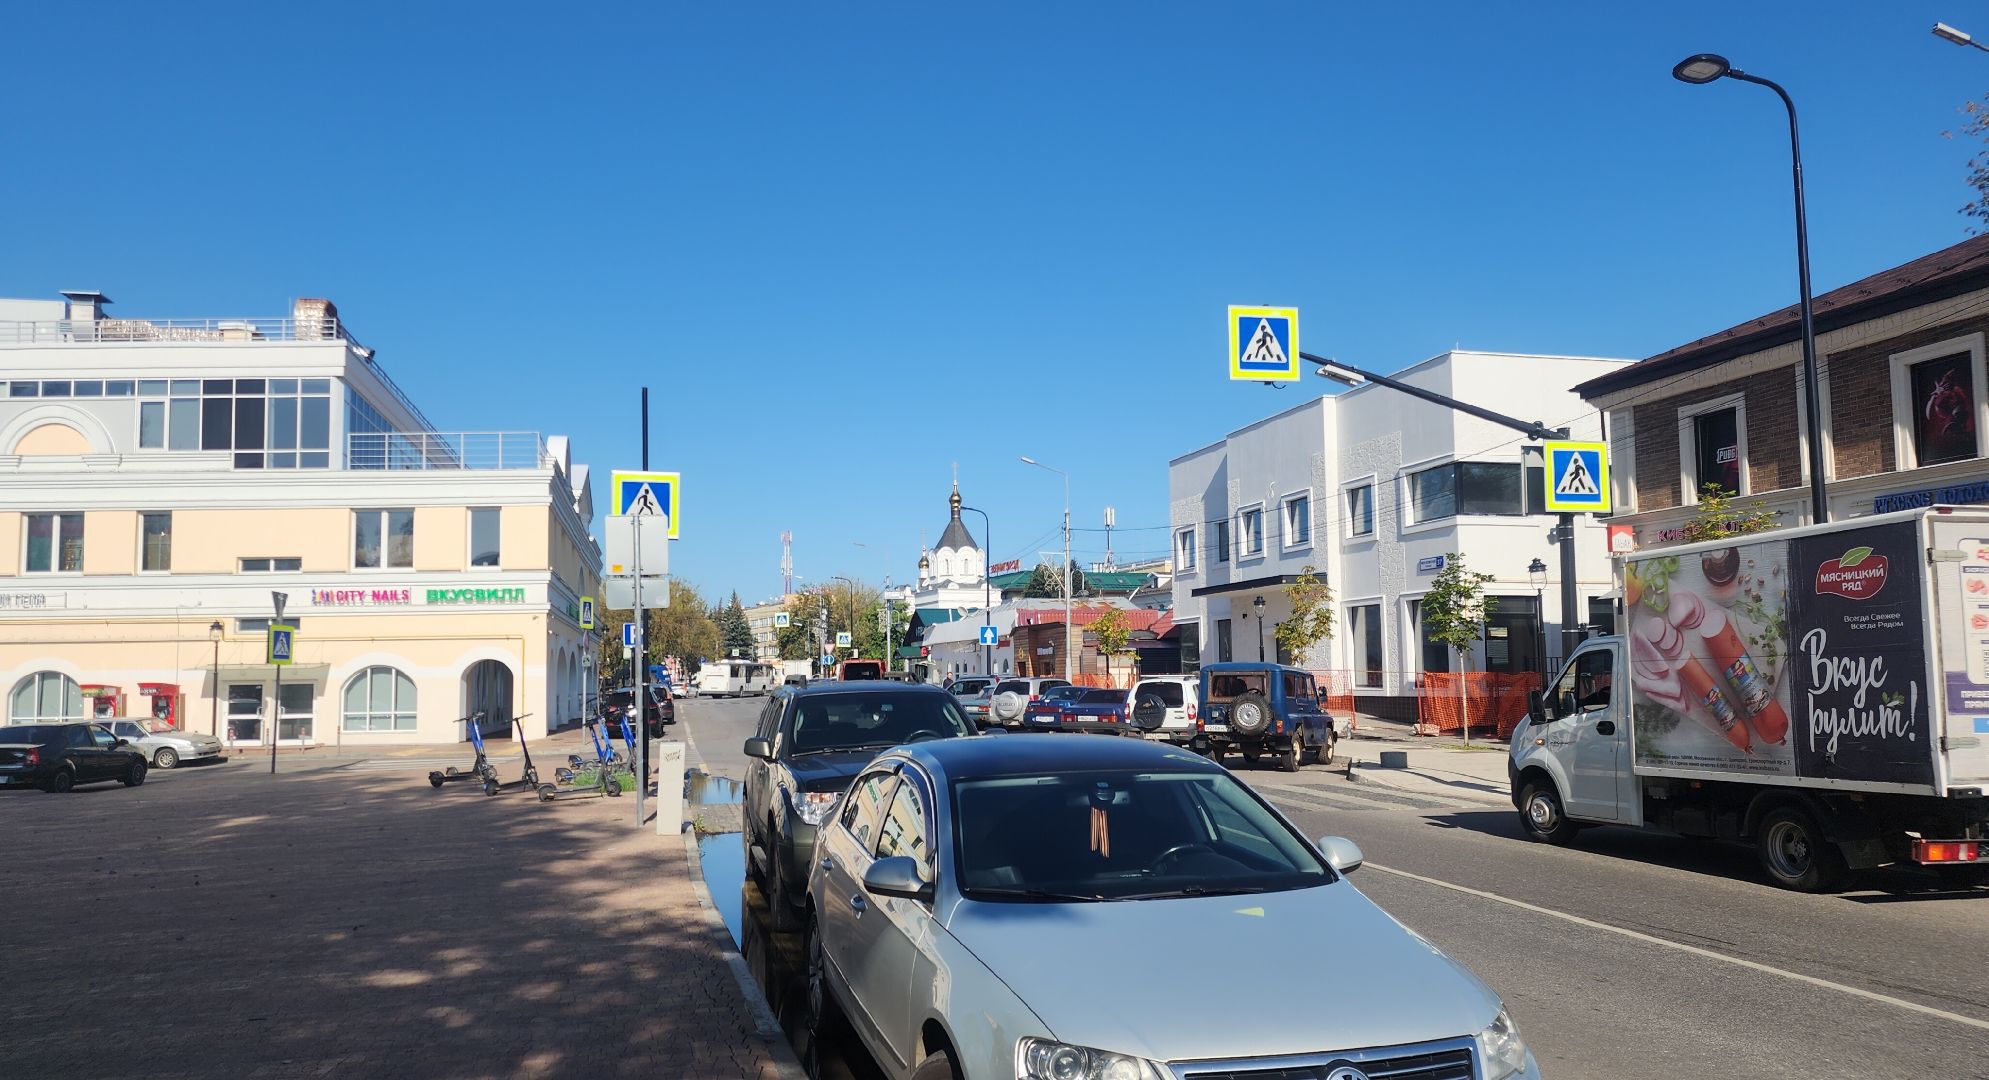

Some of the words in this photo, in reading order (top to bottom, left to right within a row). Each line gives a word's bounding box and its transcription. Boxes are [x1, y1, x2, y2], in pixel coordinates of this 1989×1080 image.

[1719, 449, 1736, 461] PUBG
[1820, 564, 1884, 583] МЯСНИЦКИЙ
[336, 590, 365, 602] CITY
[372, 589, 409, 602] NAILS
[427, 588, 525, 604] ВКУСВИЛЛ
[1844, 615, 1869, 624] Всегда
[1871, 613, 1901, 621] Свежее
[1851, 622, 1876, 630] Всегда
[1800, 628, 1888, 708] Вкус
